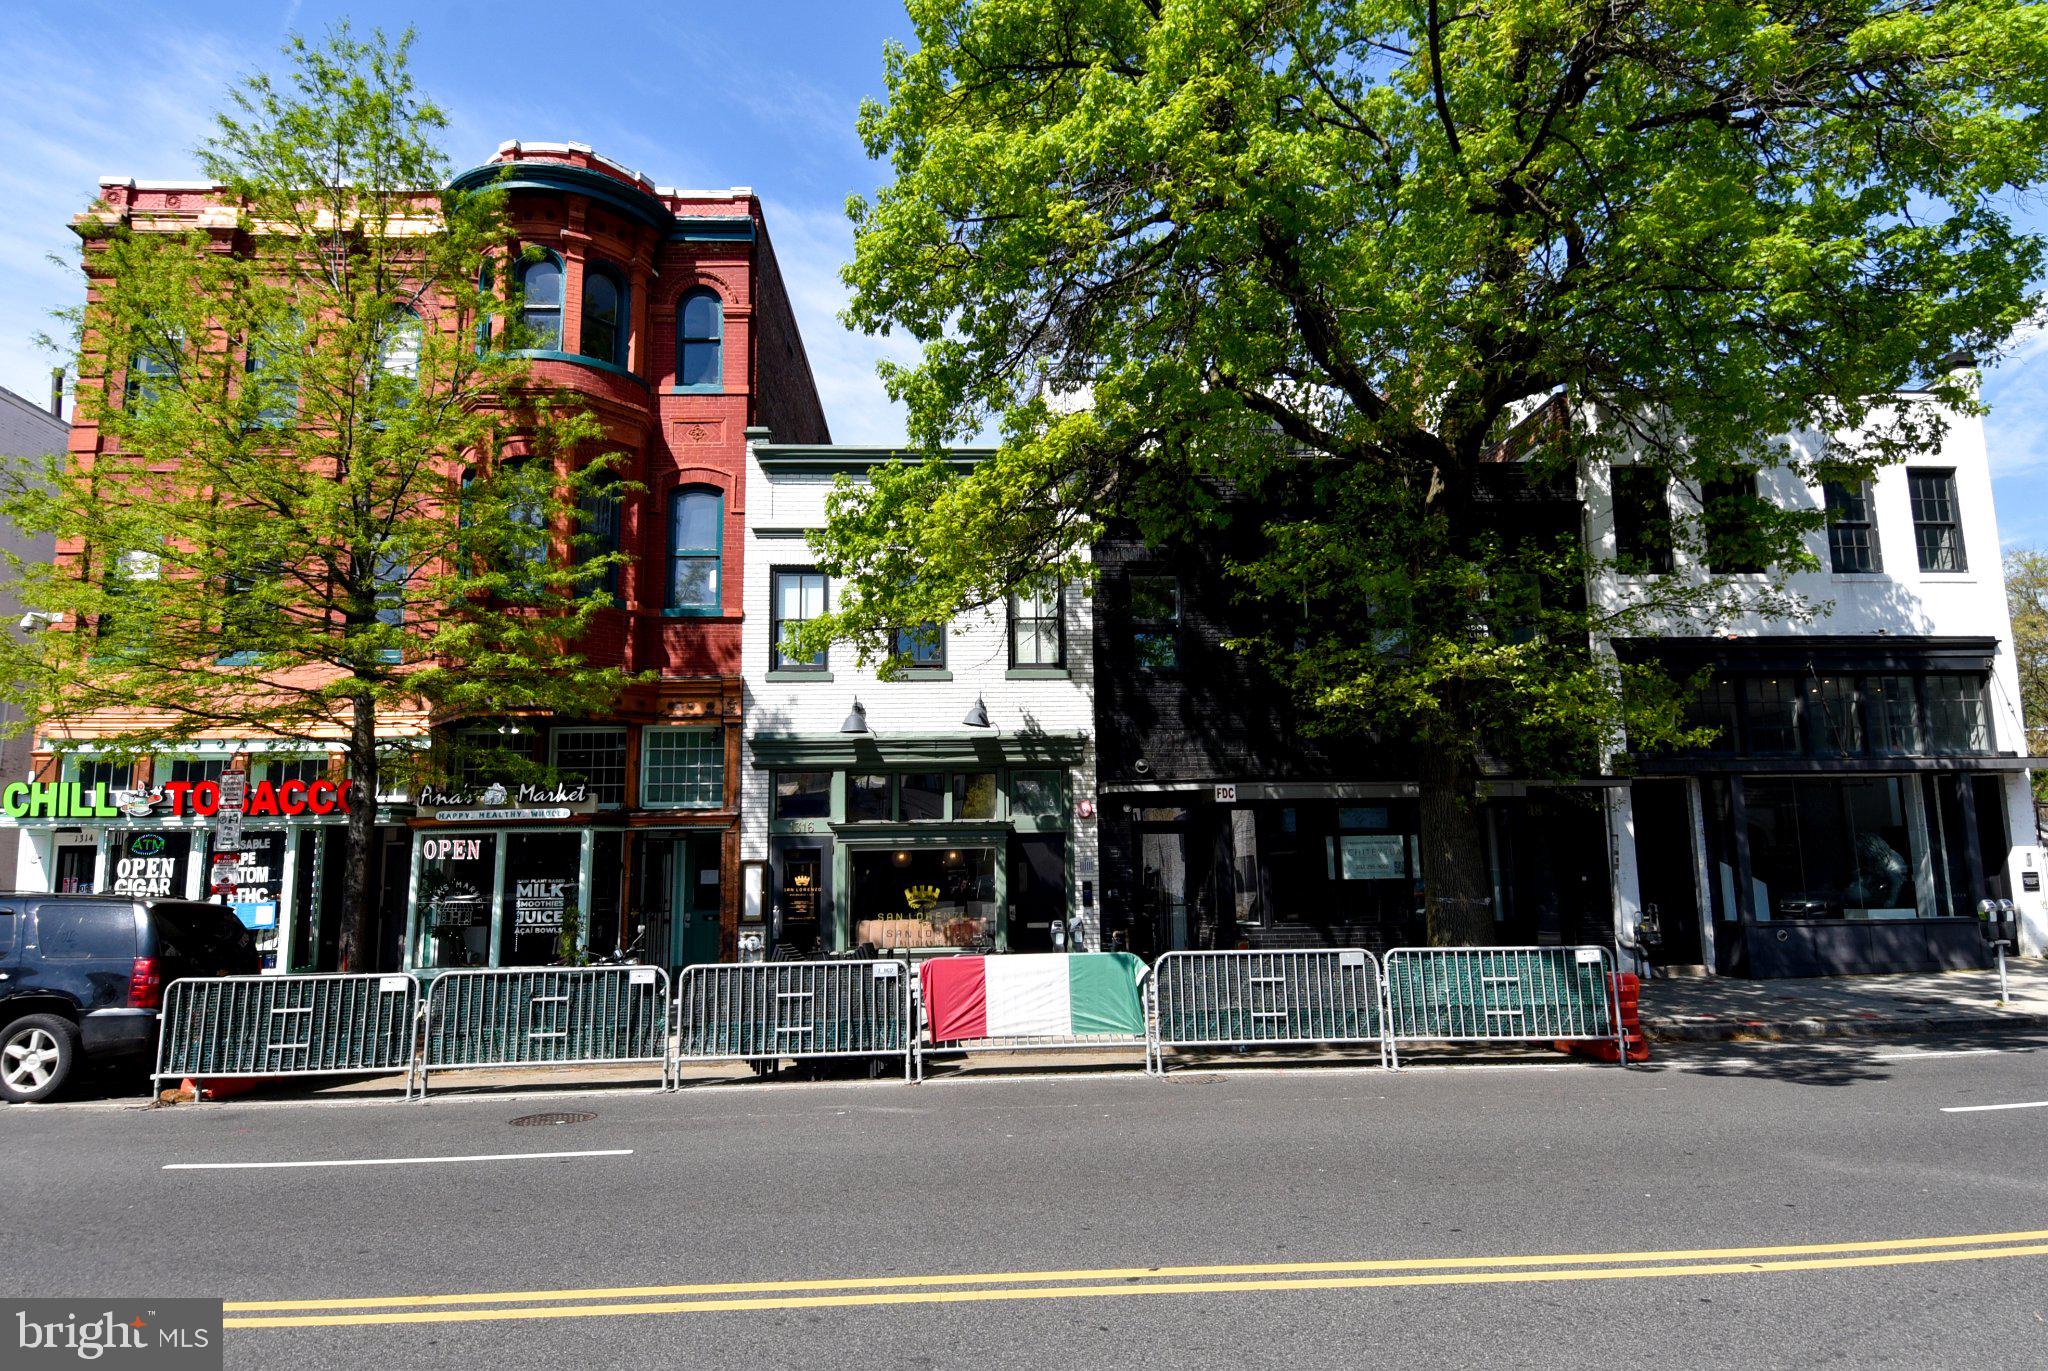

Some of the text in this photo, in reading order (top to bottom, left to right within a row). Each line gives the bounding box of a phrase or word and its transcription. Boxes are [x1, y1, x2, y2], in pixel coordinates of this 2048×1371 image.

[518, 781, 587, 803] Market
[1216, 787, 1235, 799] FDC
[3, 781, 118, 818] CHILL
[789, 821, 815, 834] 1316
[74, 833, 94, 843] 1314
[131, 838, 166, 851] ATM
[423, 839, 481, 860] OPEN
[116, 857, 176, 879] OPEN
[113, 877, 171, 897] CIGAR
[516, 883, 565, 898] MILK
[516, 900, 565, 908] SMOOTHIES
[515, 910, 564, 924] JUICE
[877, 912, 970, 921] SAN LORENZO
[534, 926, 564, 934] BOWLS
